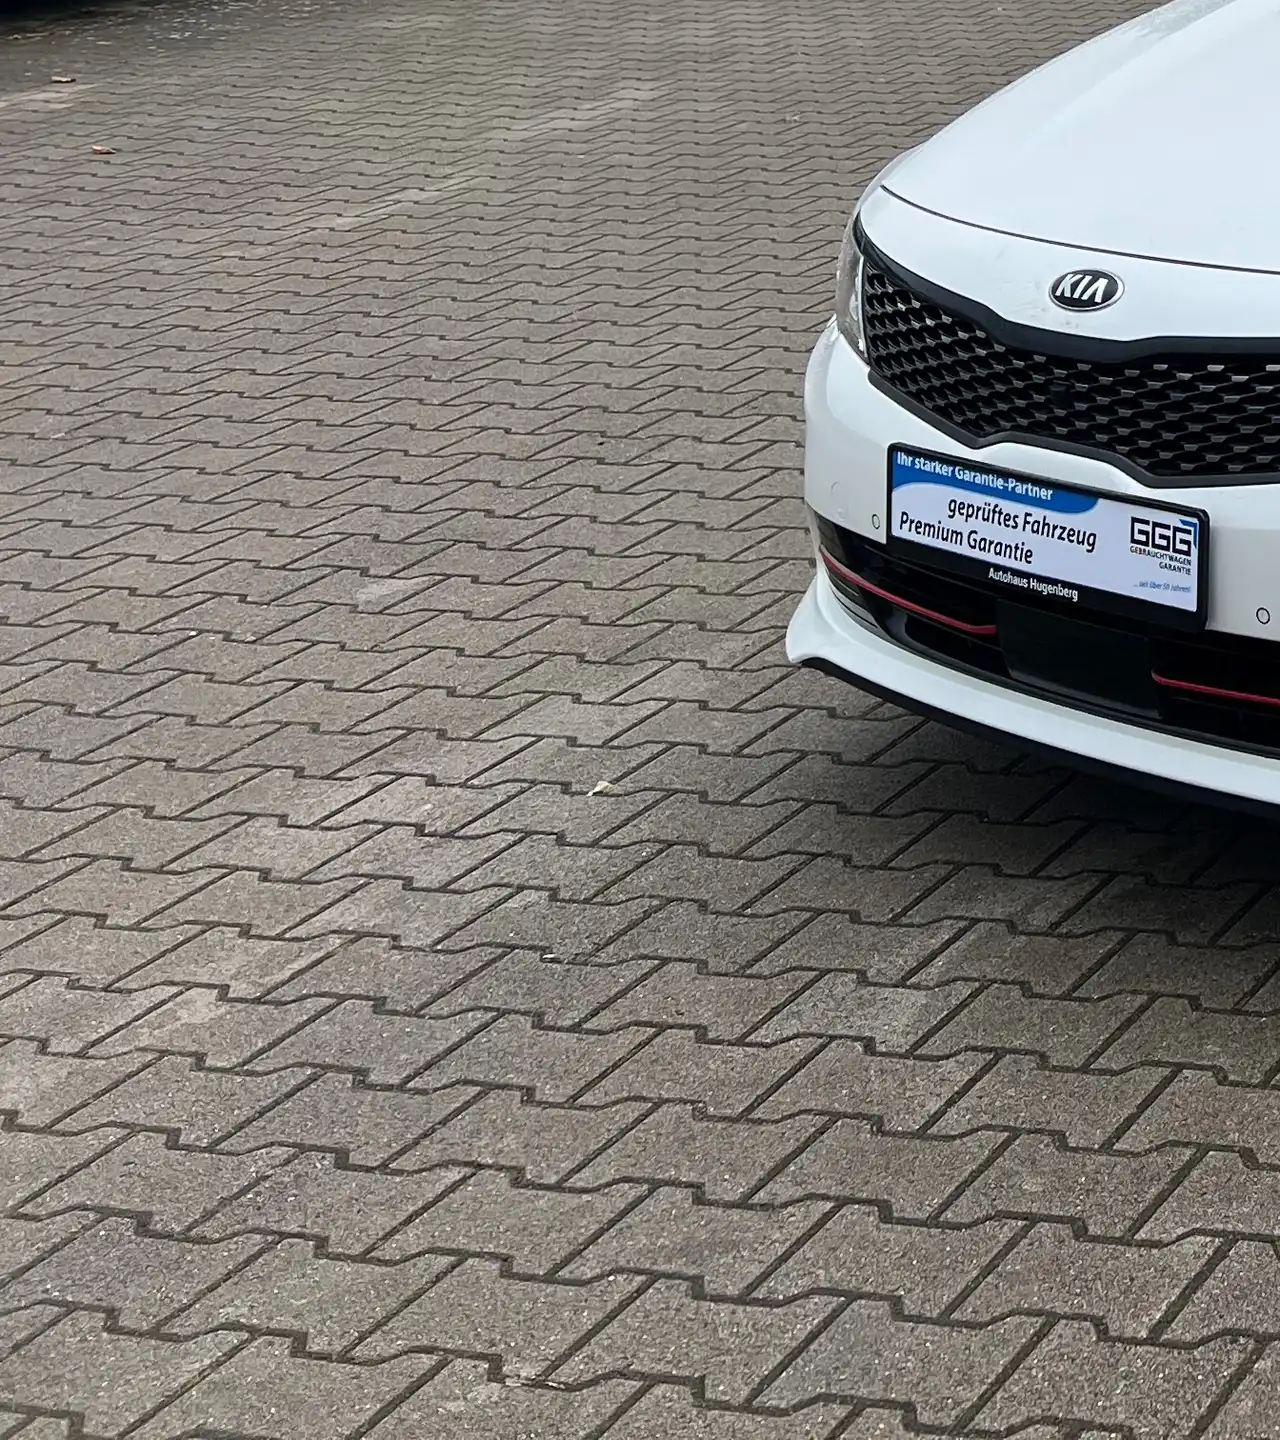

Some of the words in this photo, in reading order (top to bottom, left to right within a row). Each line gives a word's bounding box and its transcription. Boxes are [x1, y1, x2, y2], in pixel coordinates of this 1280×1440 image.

[1054, 273, 1108, 303] KIA
[897, 451, 912, 466] Ihr
[914, 457, 953, 477] starker
[955, 466, 1053, 500] Garantie-Partner
[900, 511, 963, 546] Premium
[967, 529, 1033, 564] Garantie
[948, 498, 1019, 529] geprüftes
[1022, 512, 1097, 553] Fahrzeug
[1130, 516, 1192, 557] GGG
[1130, 546, 1191, 566] GEBRAUCHTWAGEN
[1159, 562, 1191, 575] GARANTIE
[988, 567, 1028, 588] Autohaus
[1030, 577, 1078, 602] Hugenberg
